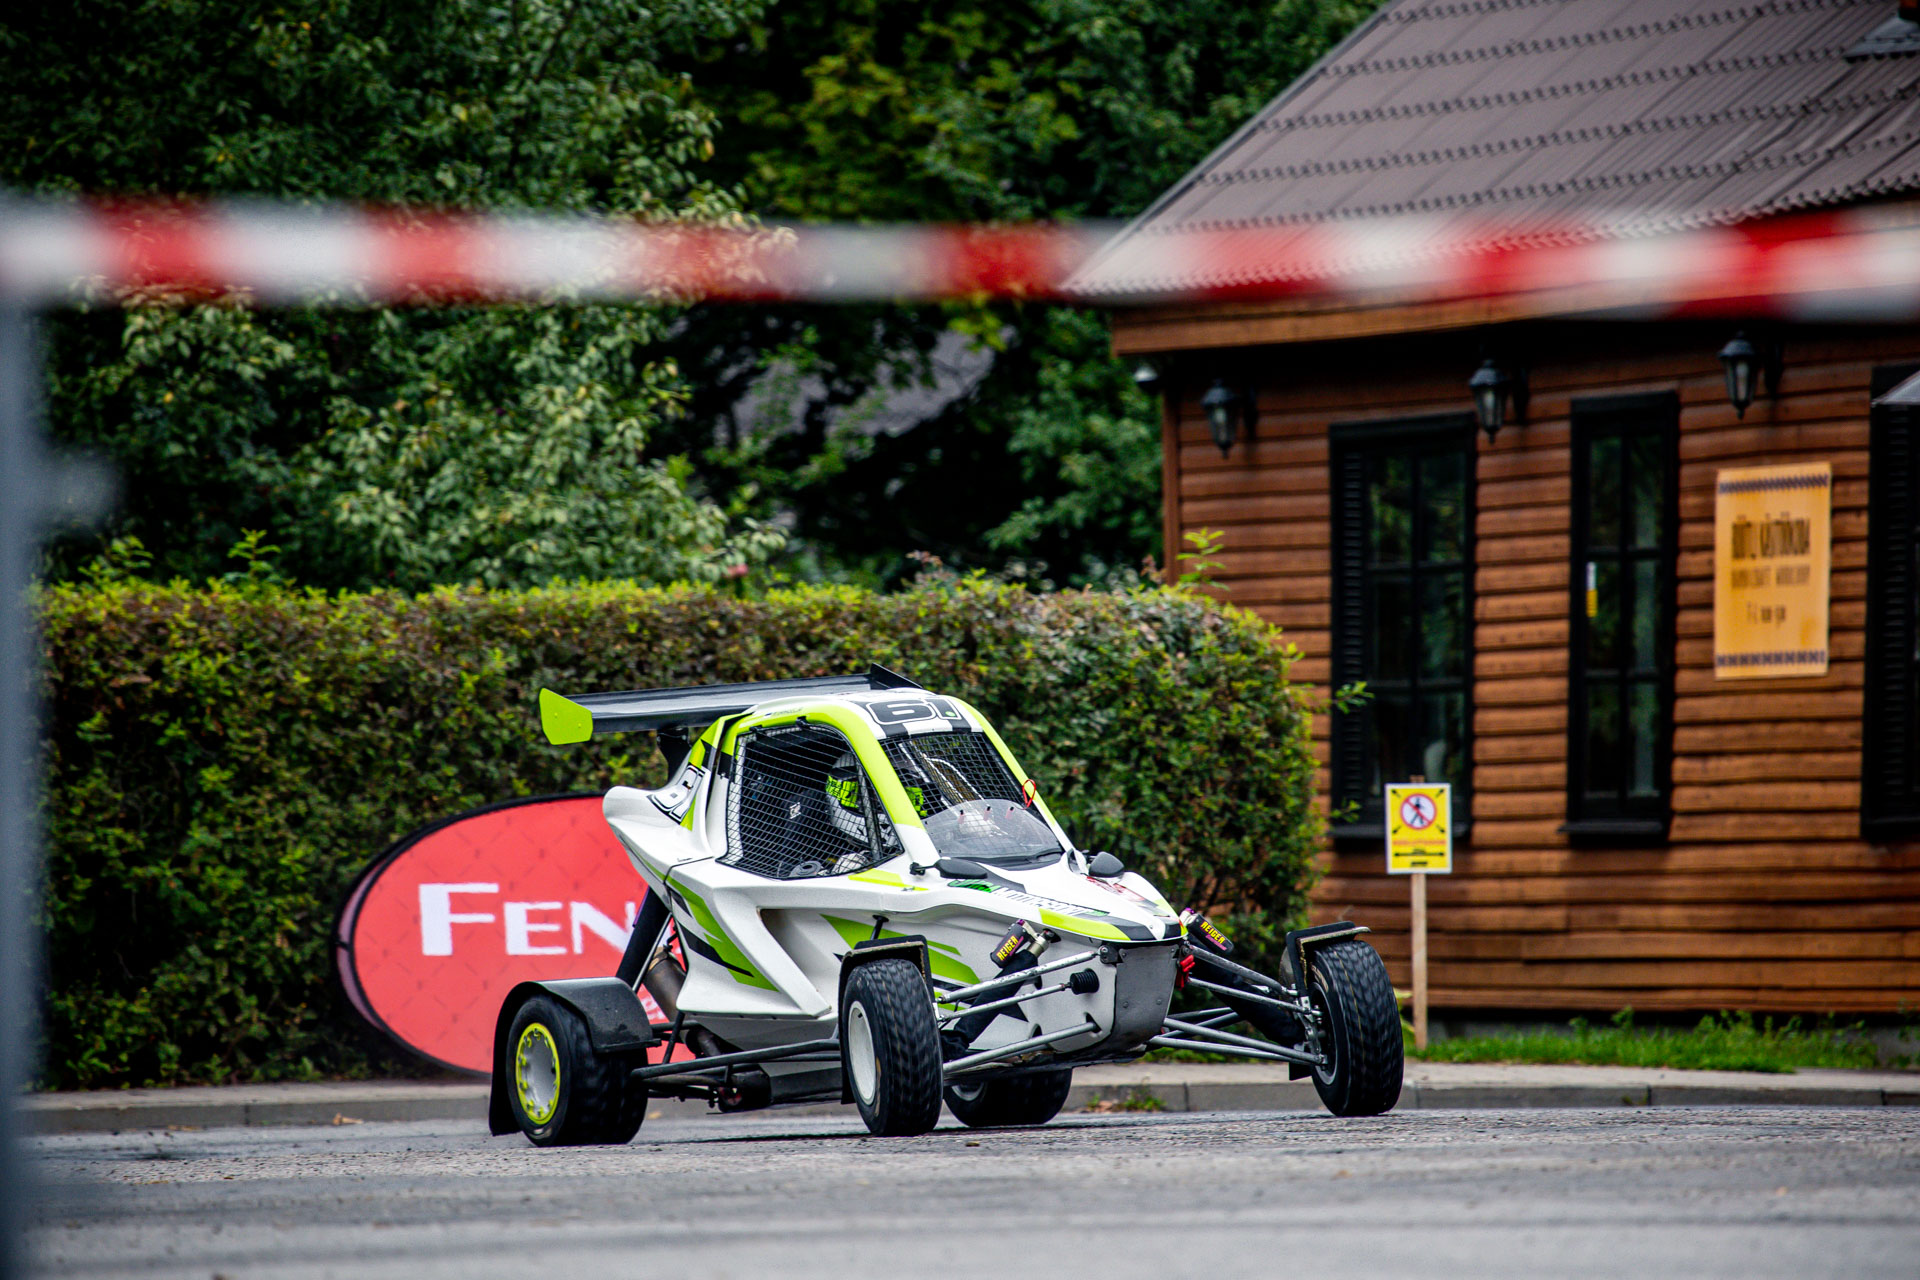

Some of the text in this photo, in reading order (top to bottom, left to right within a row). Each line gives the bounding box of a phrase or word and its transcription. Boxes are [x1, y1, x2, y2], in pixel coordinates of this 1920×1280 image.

[866, 697, 963, 726] 61
[417, 882, 682, 957] FEN
[1200, 921, 1226, 944] REIGER
[996, 935, 1019, 961] REIGER
